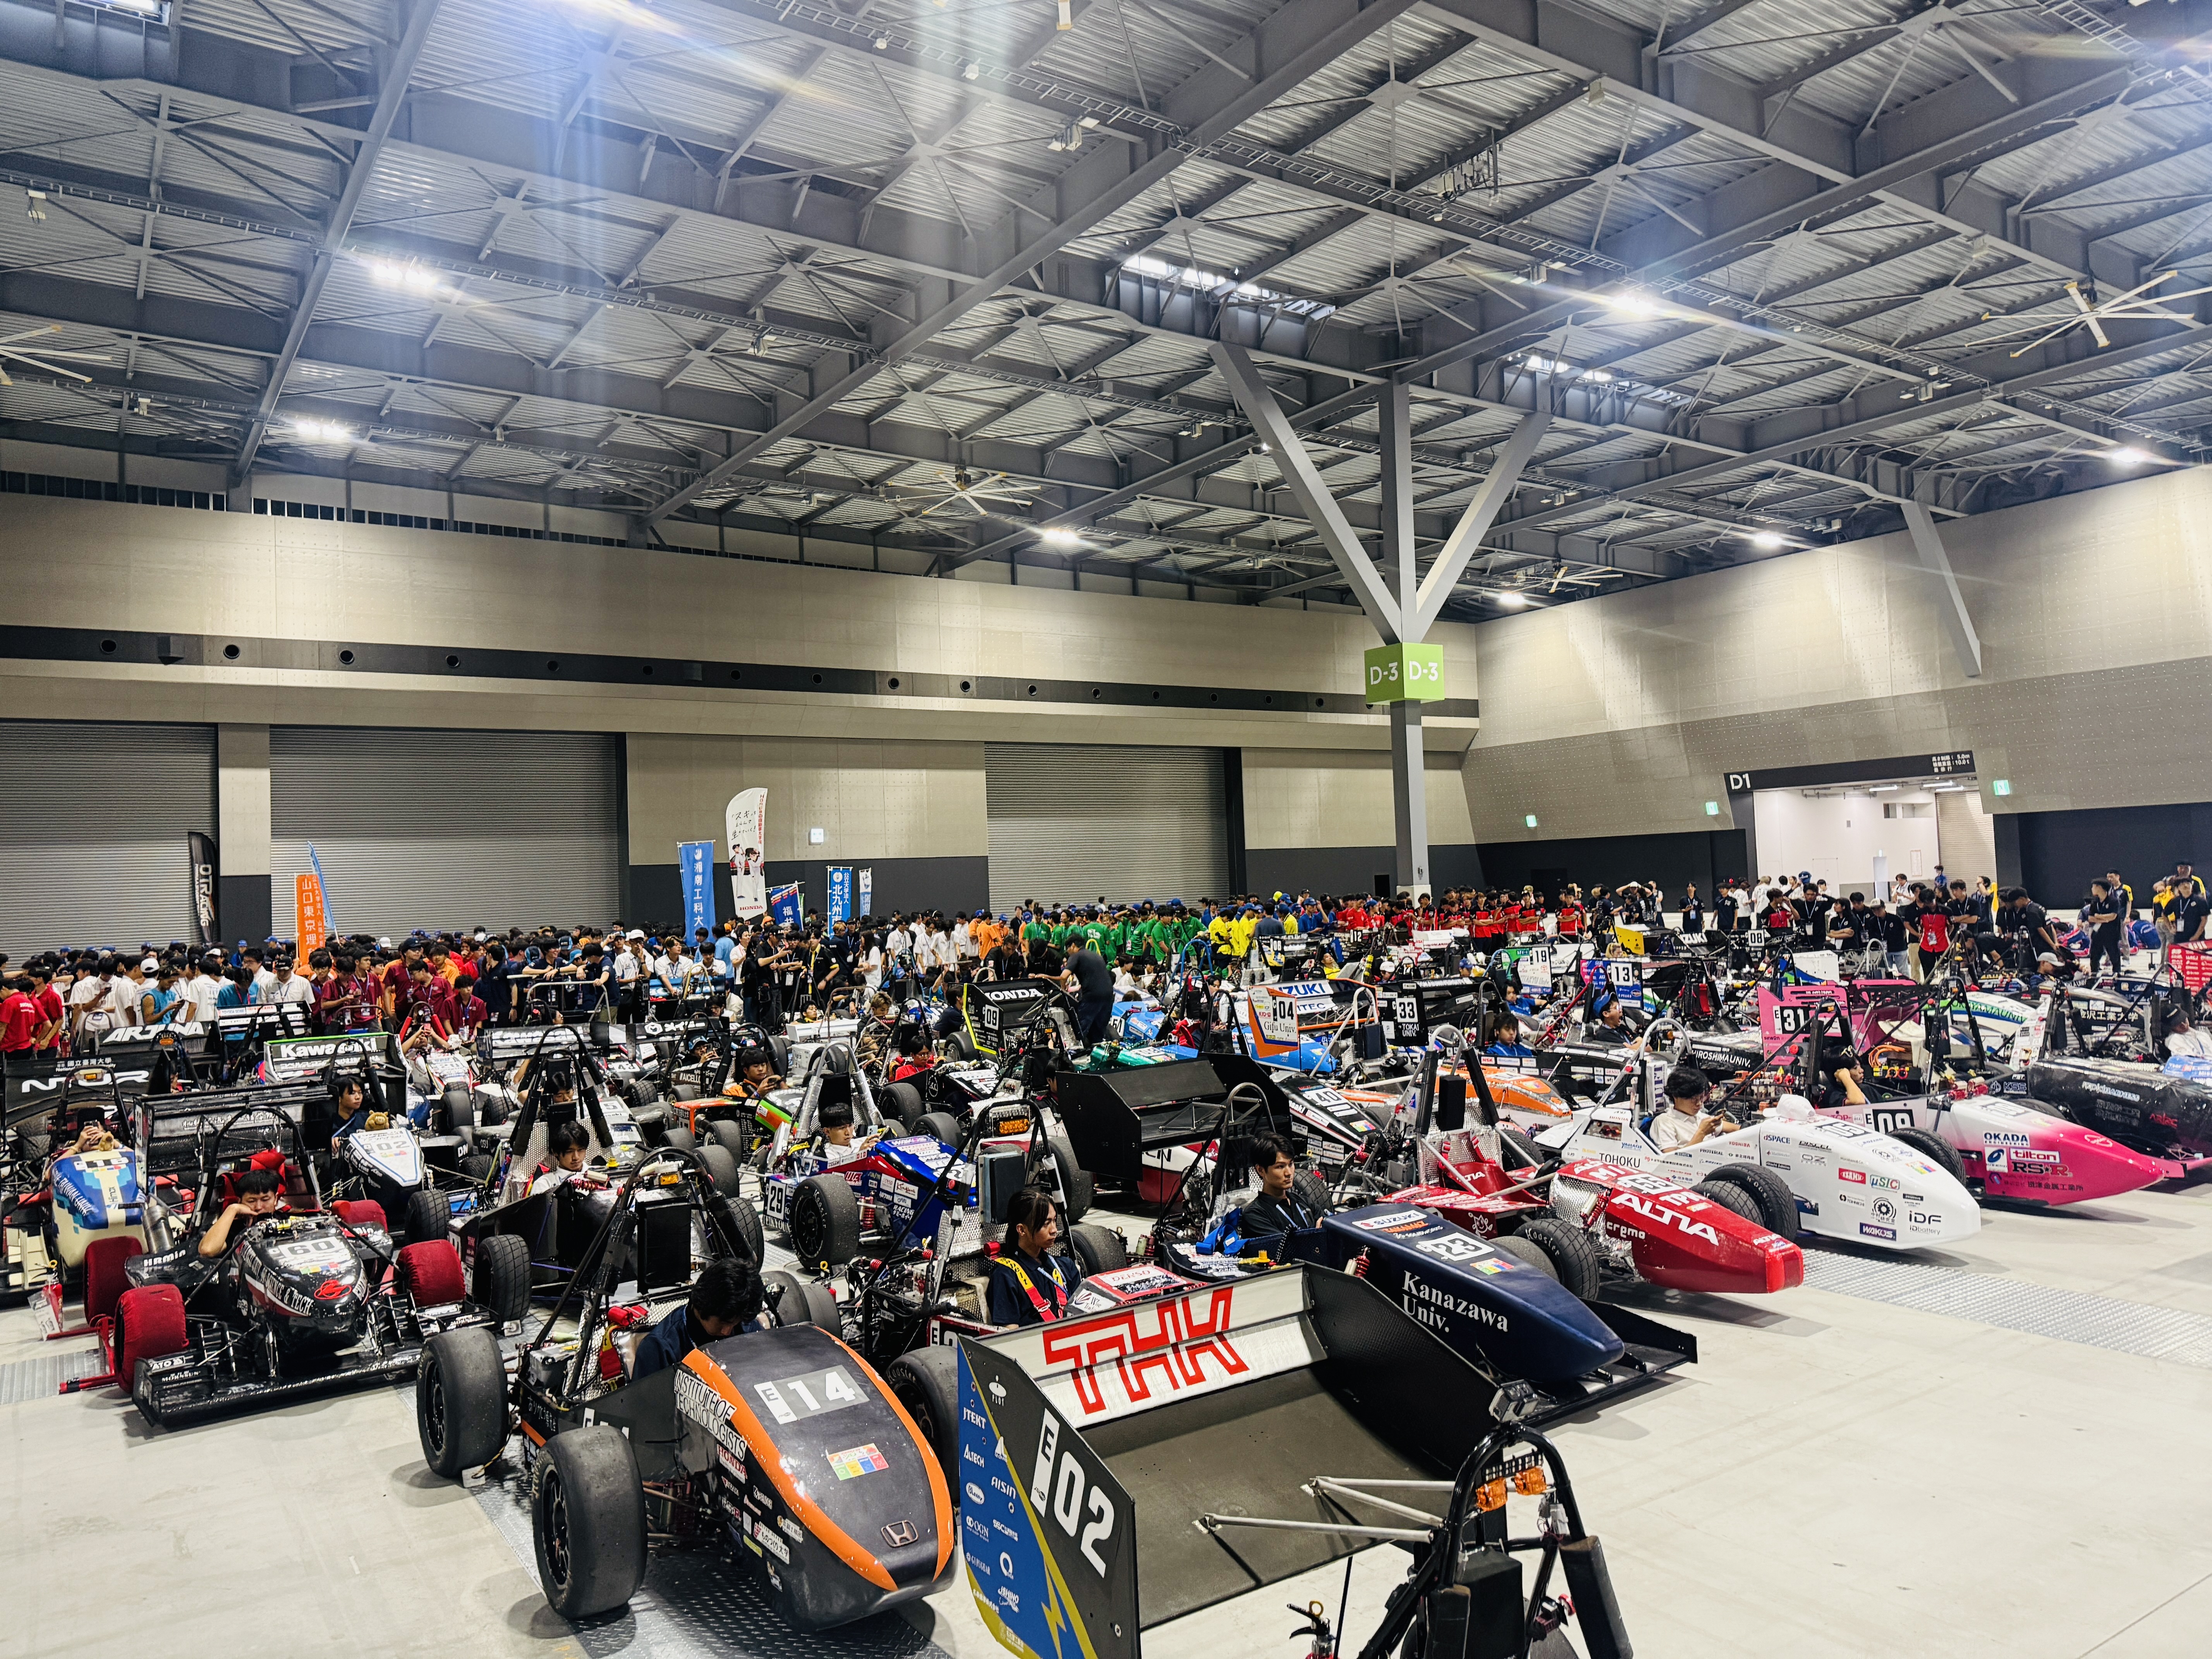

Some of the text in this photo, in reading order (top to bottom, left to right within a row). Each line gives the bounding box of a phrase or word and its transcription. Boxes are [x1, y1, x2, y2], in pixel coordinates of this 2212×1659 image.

[1370, 662, 1398, 685] D-3
[1409, 661, 1438, 681] D-3
[1729, 773, 1751, 790] D1
[694, 862, 703, 927] 湘南工科大
[1681, 933, 1707, 944] ZUKI
[1750, 933, 1762, 943] 08
[1615, 966, 1630, 982] 13
[1279, 983, 1326, 995] ZUKI
[987, 1009, 997, 1026] 09
[1279, 1001, 1294, 1020] 04
[1392, 1001, 1416, 1019] C 33
[1264, 1021, 1296, 1033] Gifu Univ.
[1402, 1024, 1419, 1032] TOKAI
[1774, 1009, 1805, 1031] E 31
[1692, 1049, 1751, 1068] HIROSHIMA UNIV.
[1316, 1091, 1342, 1103] 40
[1865, 1113, 1872, 1124] E
[376, 1141, 410, 1151] 02
[1764, 1134, 1790, 1144] dSPACE
[1984, 1132, 2028, 1142] OKADA
[1599, 1153, 1640, 1168] TOHOKU
[1802, 1154, 1826, 1162] OZ
[2013, 1150, 2056, 1161] tilton
[766, 1183, 783, 1214] C 29
[1374, 1213, 1420, 1225] SUZUKI
[1610, 1194, 1719, 1246] ALTIA
[1909, 1210, 1941, 1224] iDF
[1607, 1222, 1645, 1240] cremo
[1753, 1233, 1781, 1245] ALTIA
[287, 1240, 335, 1255] 60
[1433, 1238, 1483, 1257] 23
[1112, 1269, 1150, 1282] DENSO
[1402, 1271, 1508, 1332] Kanazawa
[1403, 1294, 1450, 1333] Univ.
[931, 1327, 938, 1345] E
[1042, 1286, 1249, 1415] THK
[675, 1369, 737, 1420] INSTITUTE OF
[761, 1371, 856, 1411] E 14
[992, 1394, 1004, 1407] PLOT
[675, 1392, 745, 1458] TECHNOLOGISTS
[963, 1407, 986, 1429] JTEKT
[718, 1444, 747, 1479] HONDA
[963, 1444, 984, 1468] ALTECH
[991, 1476, 1016, 1499] AISIN
[1041, 1424, 1115, 1578] E 02
